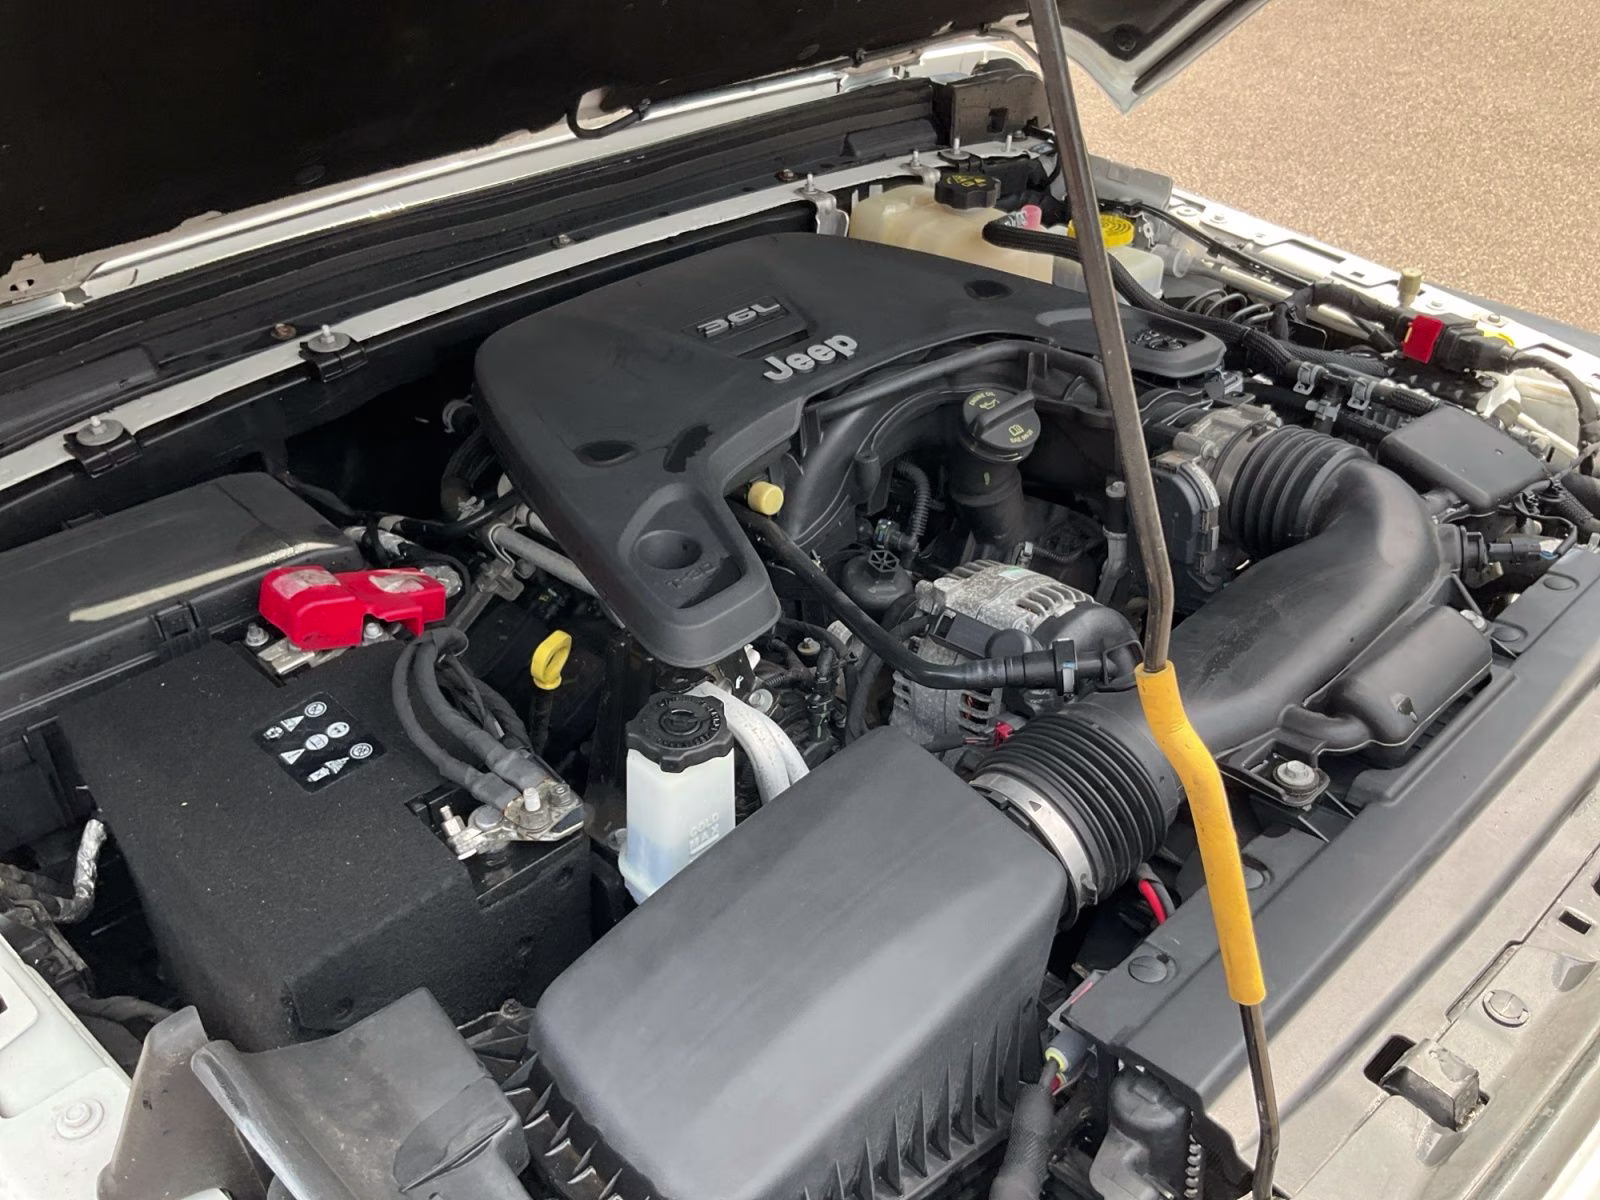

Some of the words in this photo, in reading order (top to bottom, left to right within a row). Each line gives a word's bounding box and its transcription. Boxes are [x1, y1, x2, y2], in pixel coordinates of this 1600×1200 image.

[763, 335, 857, 382] Jeep
[689, 812, 719, 837] COLD
[689, 823, 719, 847] MAX
